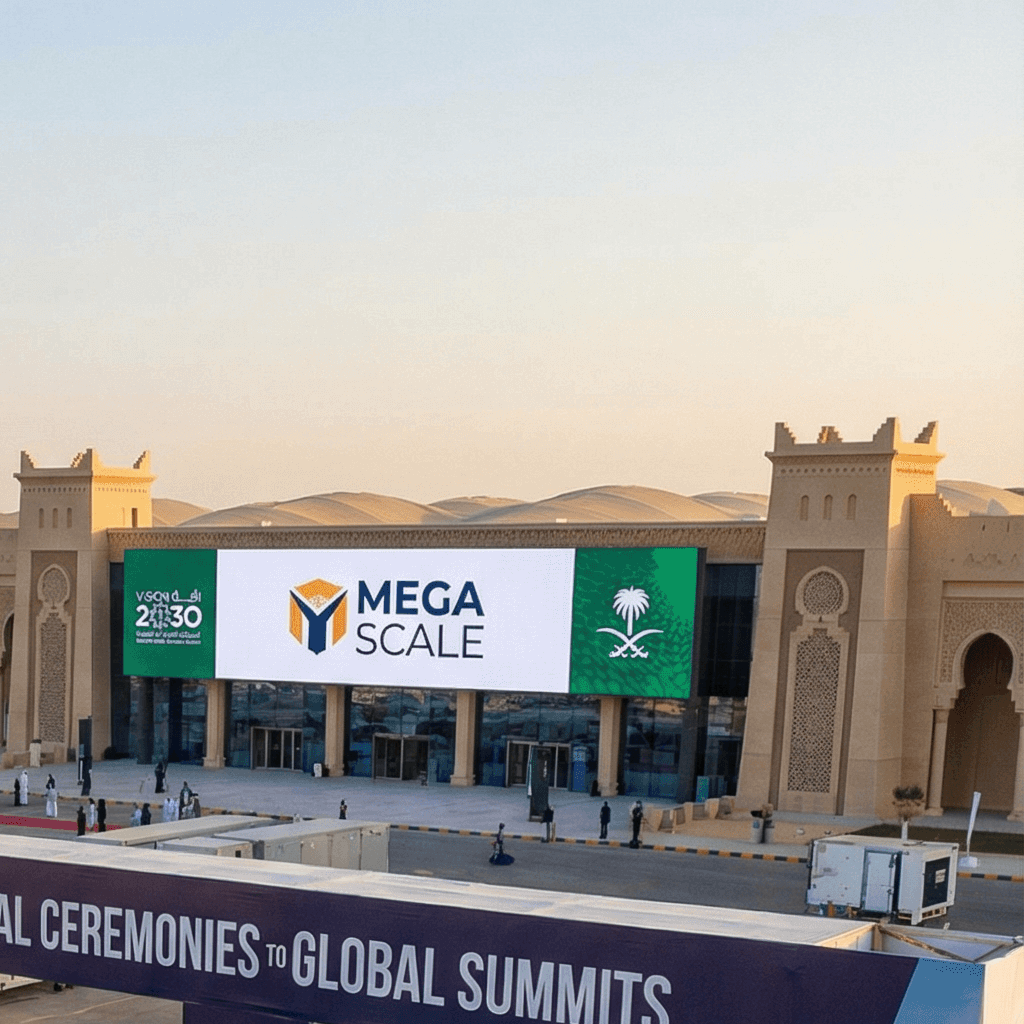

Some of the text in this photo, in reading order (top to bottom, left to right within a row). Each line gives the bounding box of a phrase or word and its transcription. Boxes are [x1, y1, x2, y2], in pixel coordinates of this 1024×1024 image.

[358, 580, 485, 616] MEGA
[356, 622, 484, 659] SCALE
[40, 899, 260, 979] CEREMONIES
[266, 943, 286, 969] TO
[292, 930, 445, 1007] GLOBAL
